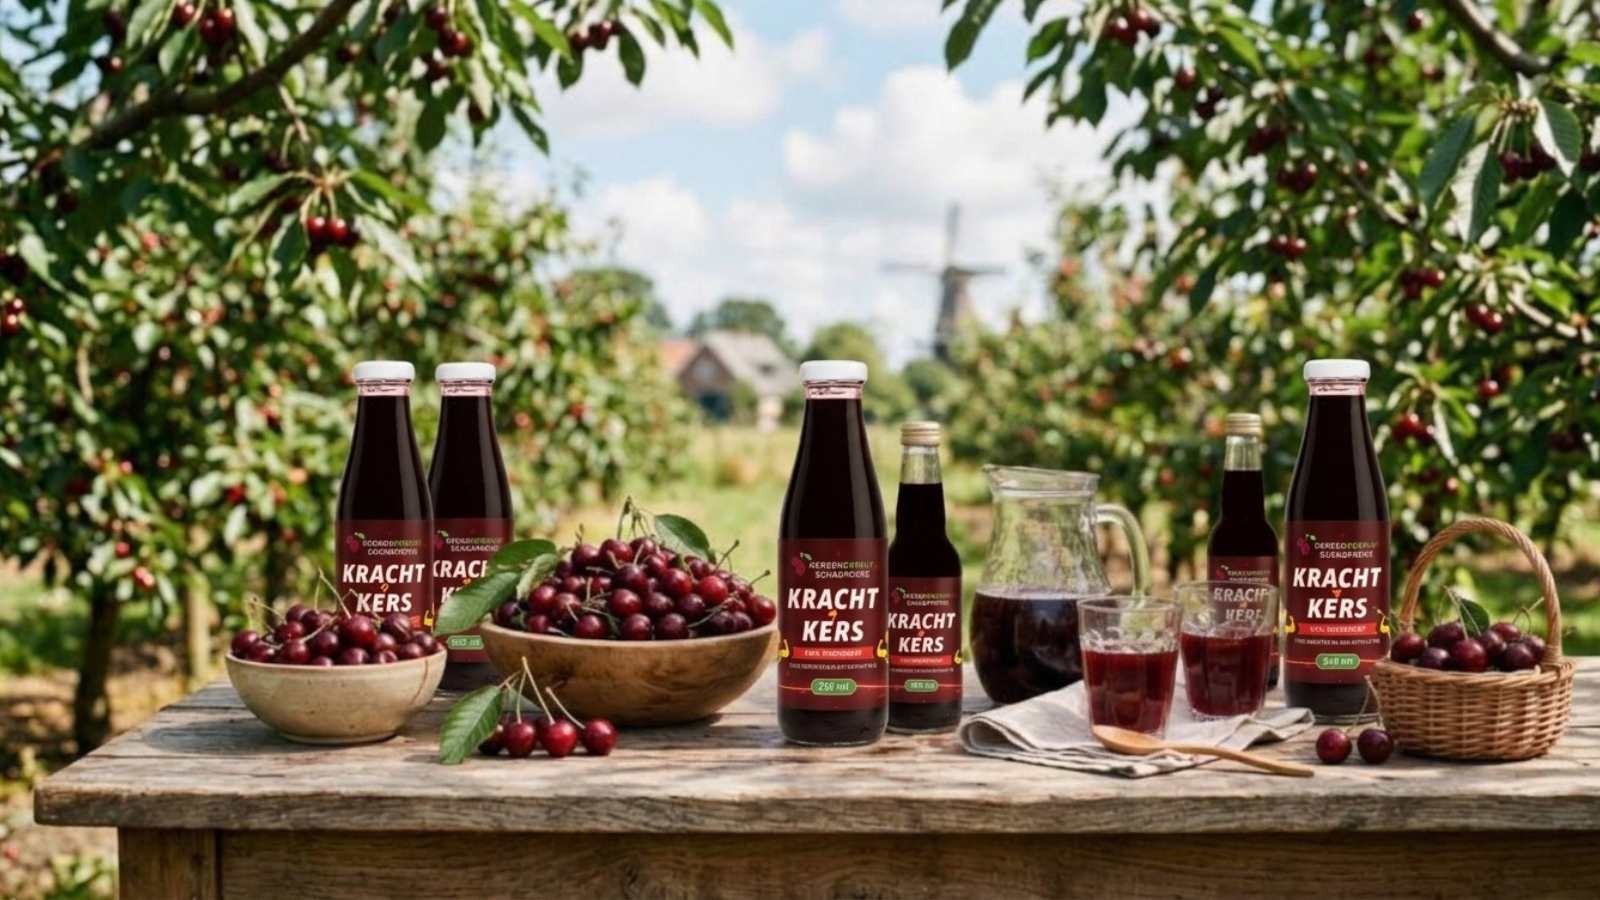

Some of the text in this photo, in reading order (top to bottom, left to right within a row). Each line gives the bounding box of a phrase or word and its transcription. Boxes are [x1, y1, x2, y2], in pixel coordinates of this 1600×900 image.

[343, 564, 425, 584] KRACHT
[1293, 567, 1382, 588] KRACHT
[356, 593, 412, 613] KERS
[788, 587, 879, 609] KRACHT
[1307, 598, 1368, 619] KERS
[802, 620, 864, 642] KERS
[888, 612, 956, 630] KRACHT
[898, 636, 944, 653] KERS
